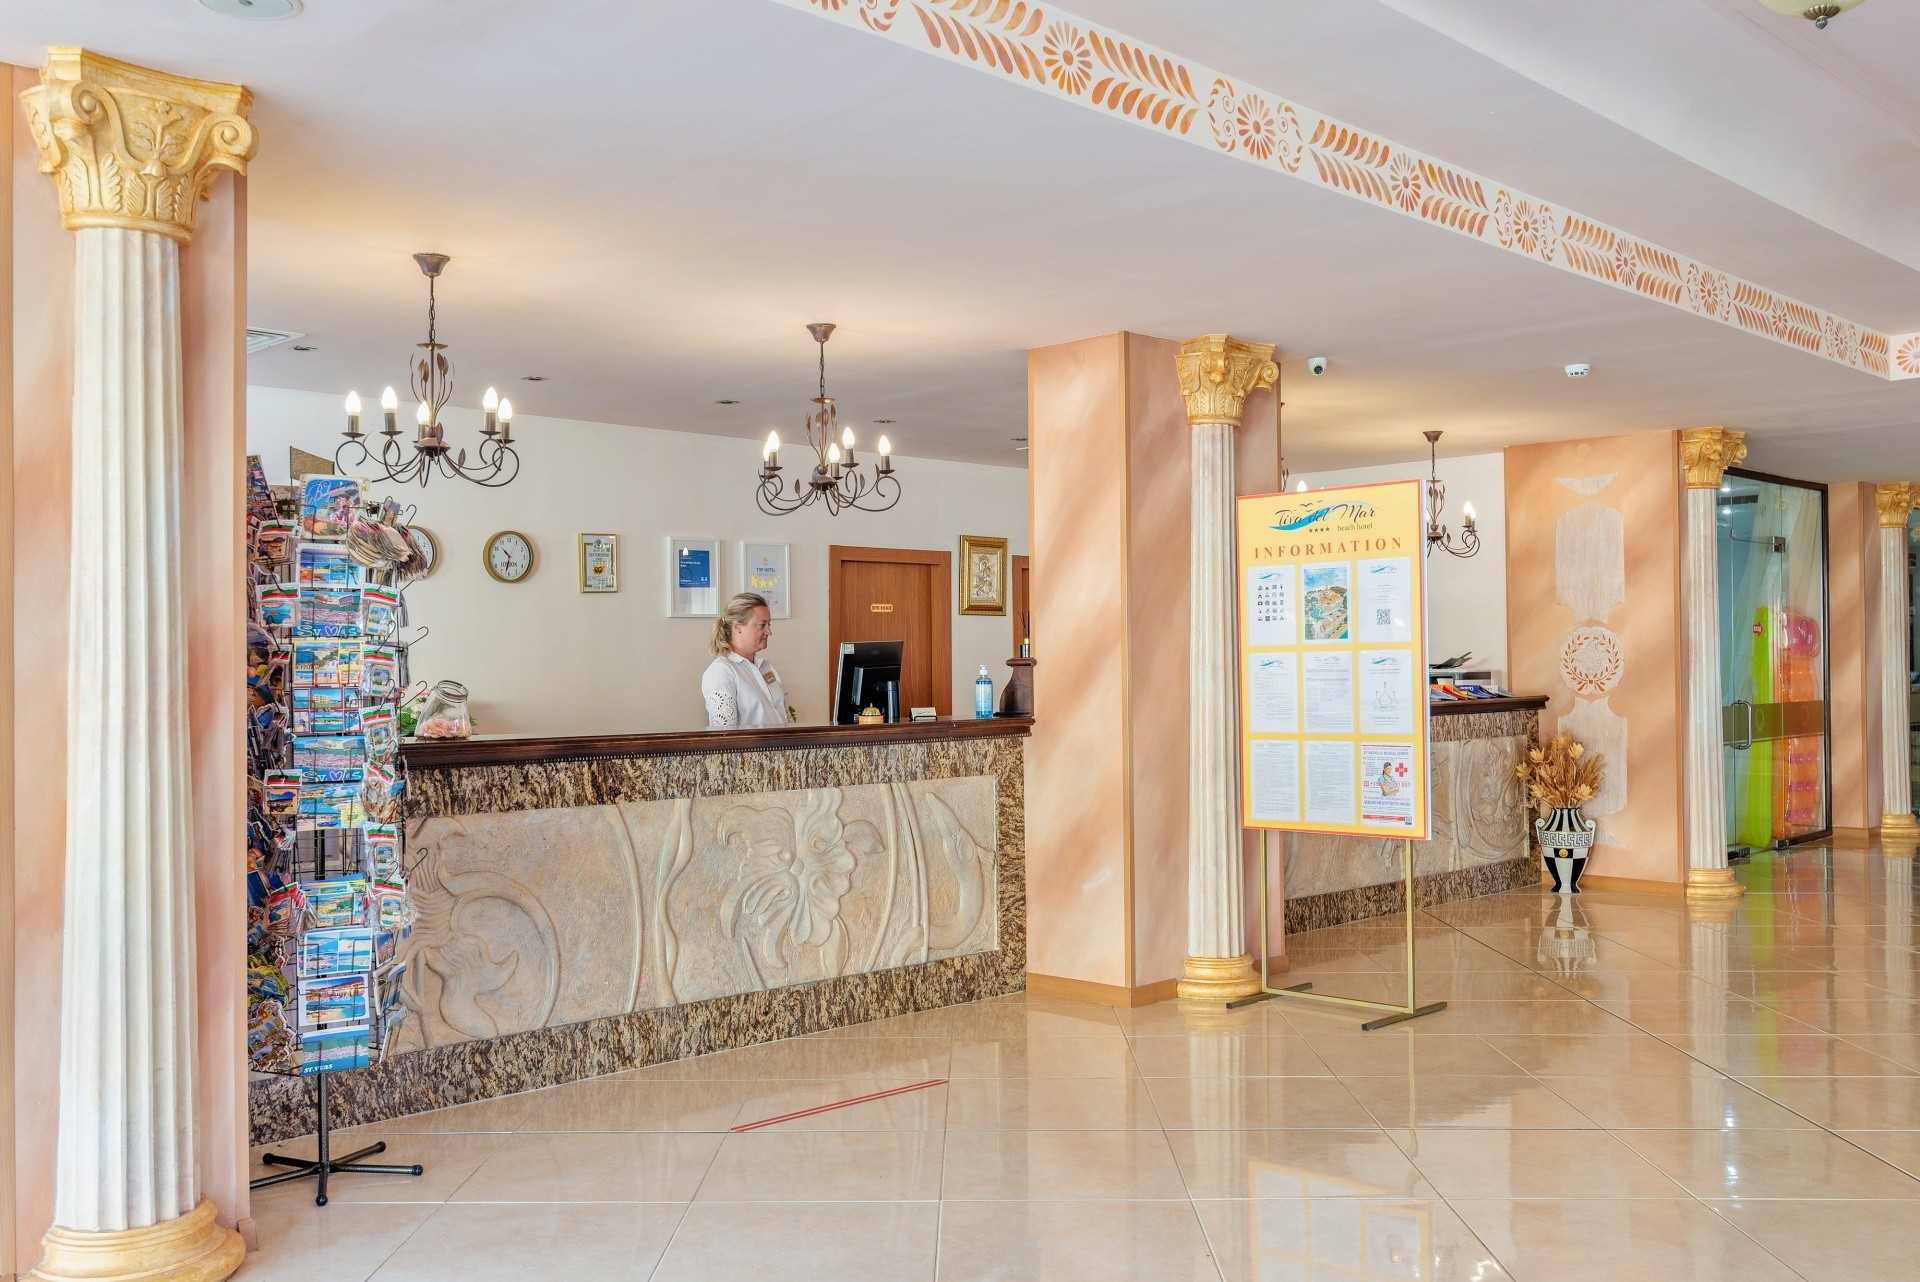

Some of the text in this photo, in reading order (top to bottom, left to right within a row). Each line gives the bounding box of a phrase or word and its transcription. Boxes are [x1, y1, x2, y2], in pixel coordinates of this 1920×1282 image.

[1275, 504, 1377, 526] Tiva del Mar
[1337, 522, 1373, 532] beach hotel
[1254, 537, 1402, 559] INFORMATION
